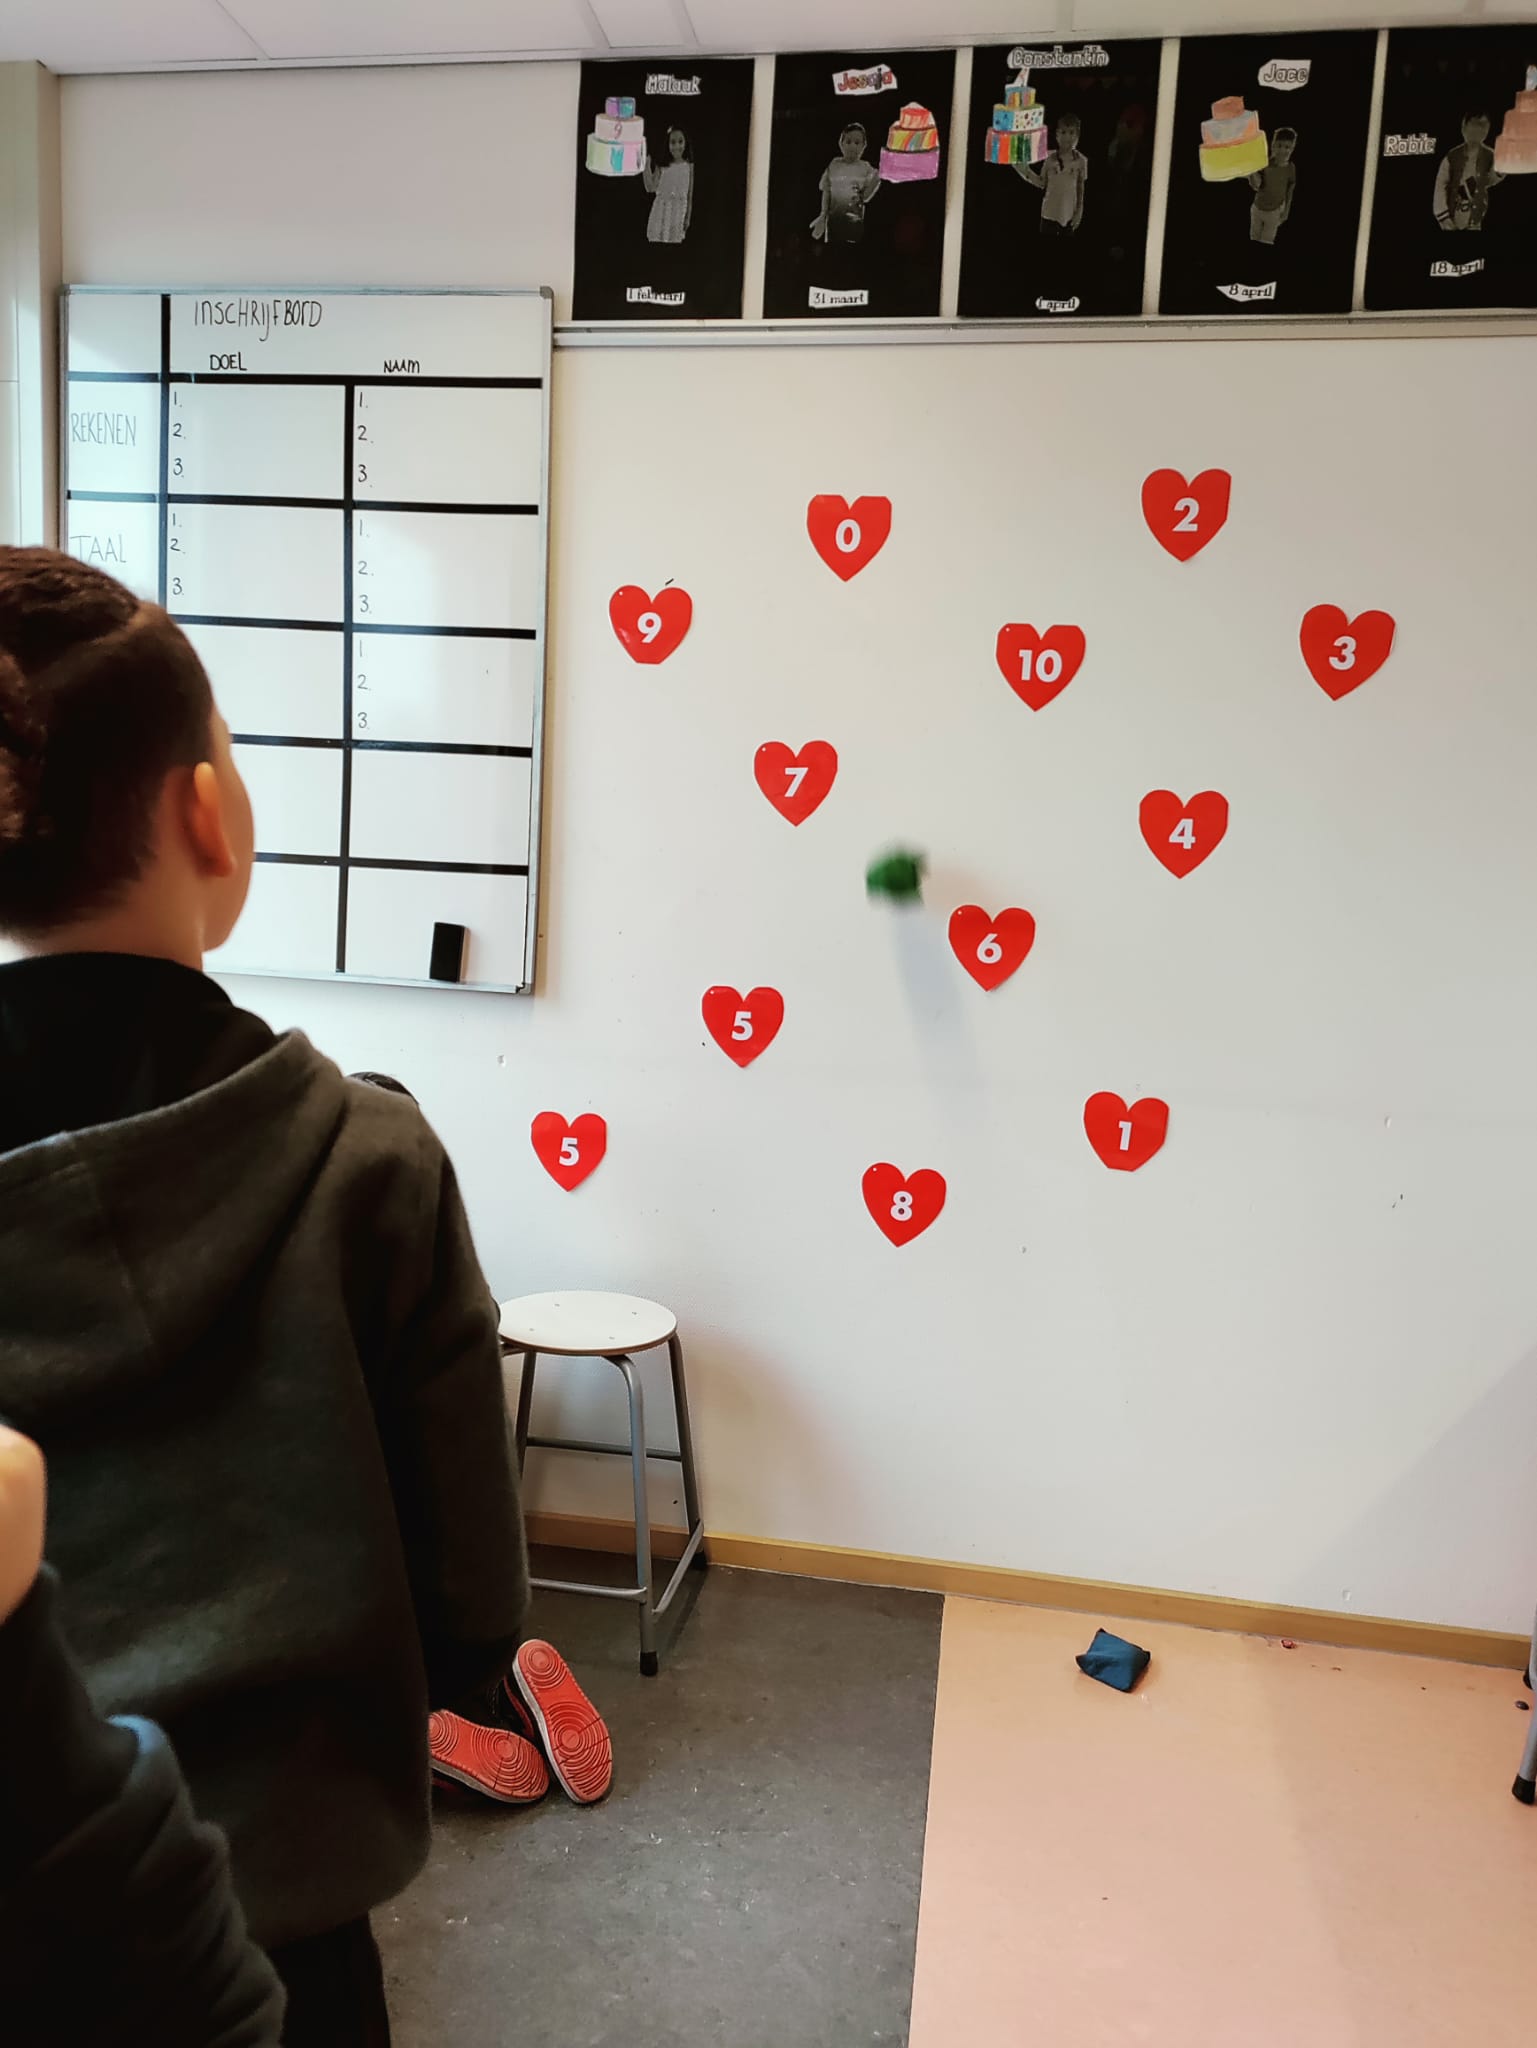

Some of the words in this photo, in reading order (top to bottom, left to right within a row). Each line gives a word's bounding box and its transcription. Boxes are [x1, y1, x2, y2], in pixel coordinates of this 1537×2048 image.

[1011, 47, 1107, 67] Constantin
[1432, 261, 1448, 274] 18
[1450, 259, 1485, 276] april
[814, 292, 825, 304] 31
[830, 292, 864, 304] maart
[1047, 298, 1076, 311] april
[1229, 283, 1239, 296] 8
[1241, 285, 1272, 299] april
[209, 351, 248, 371] DOEL
[70, 411, 137, 447] REKENEN
[1173, 498, 1199, 531] 2
[69, 533, 127, 564] TAAL
[836, 519, 861, 552] 0
[638, 612, 662, 643] 9
[1019, 650, 1062, 682] 10
[1329, 636, 1356, 670] 3
[785, 767, 808, 797] 7
[1169, 819, 1195, 849] 4
[977, 934, 1002, 963] 6
[732, 1011, 753, 1040] 5
[1118, 1121, 1132, 1150] 1
[559, 1137, 579, 1166] 5
[891, 1191, 912, 1221] 8
